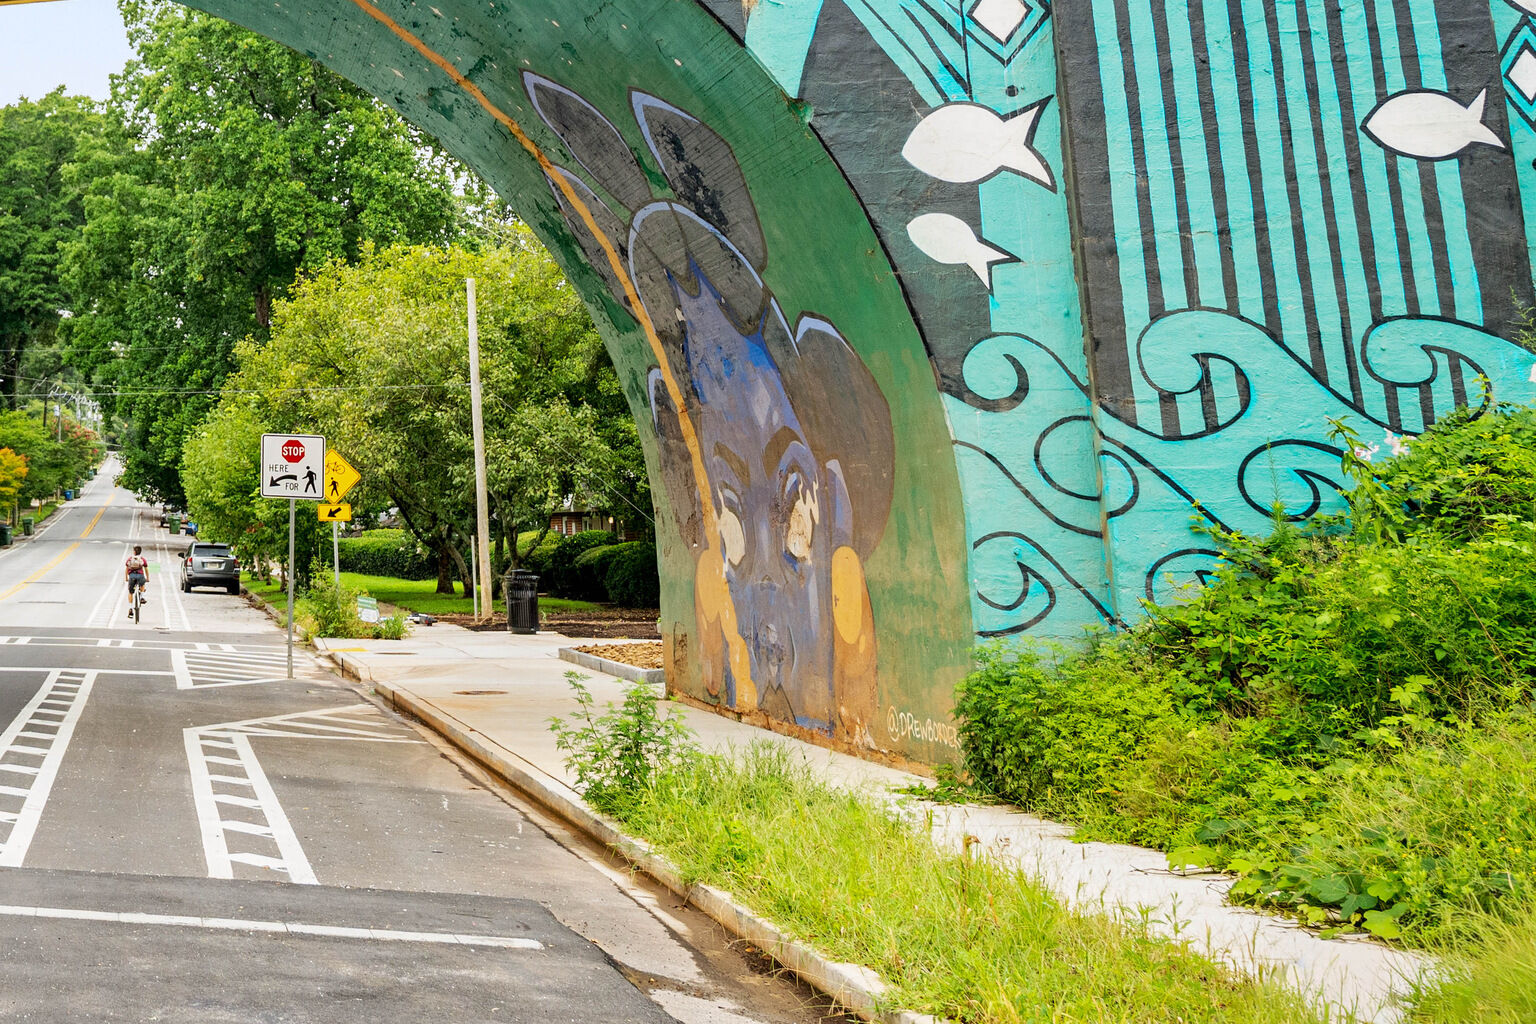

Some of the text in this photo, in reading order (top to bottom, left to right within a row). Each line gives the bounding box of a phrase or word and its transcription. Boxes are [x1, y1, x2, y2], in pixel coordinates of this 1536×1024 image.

[282, 446, 305, 456] STOP
[268, 464, 289, 473] HERE
[285, 482, 299, 491] FOR
